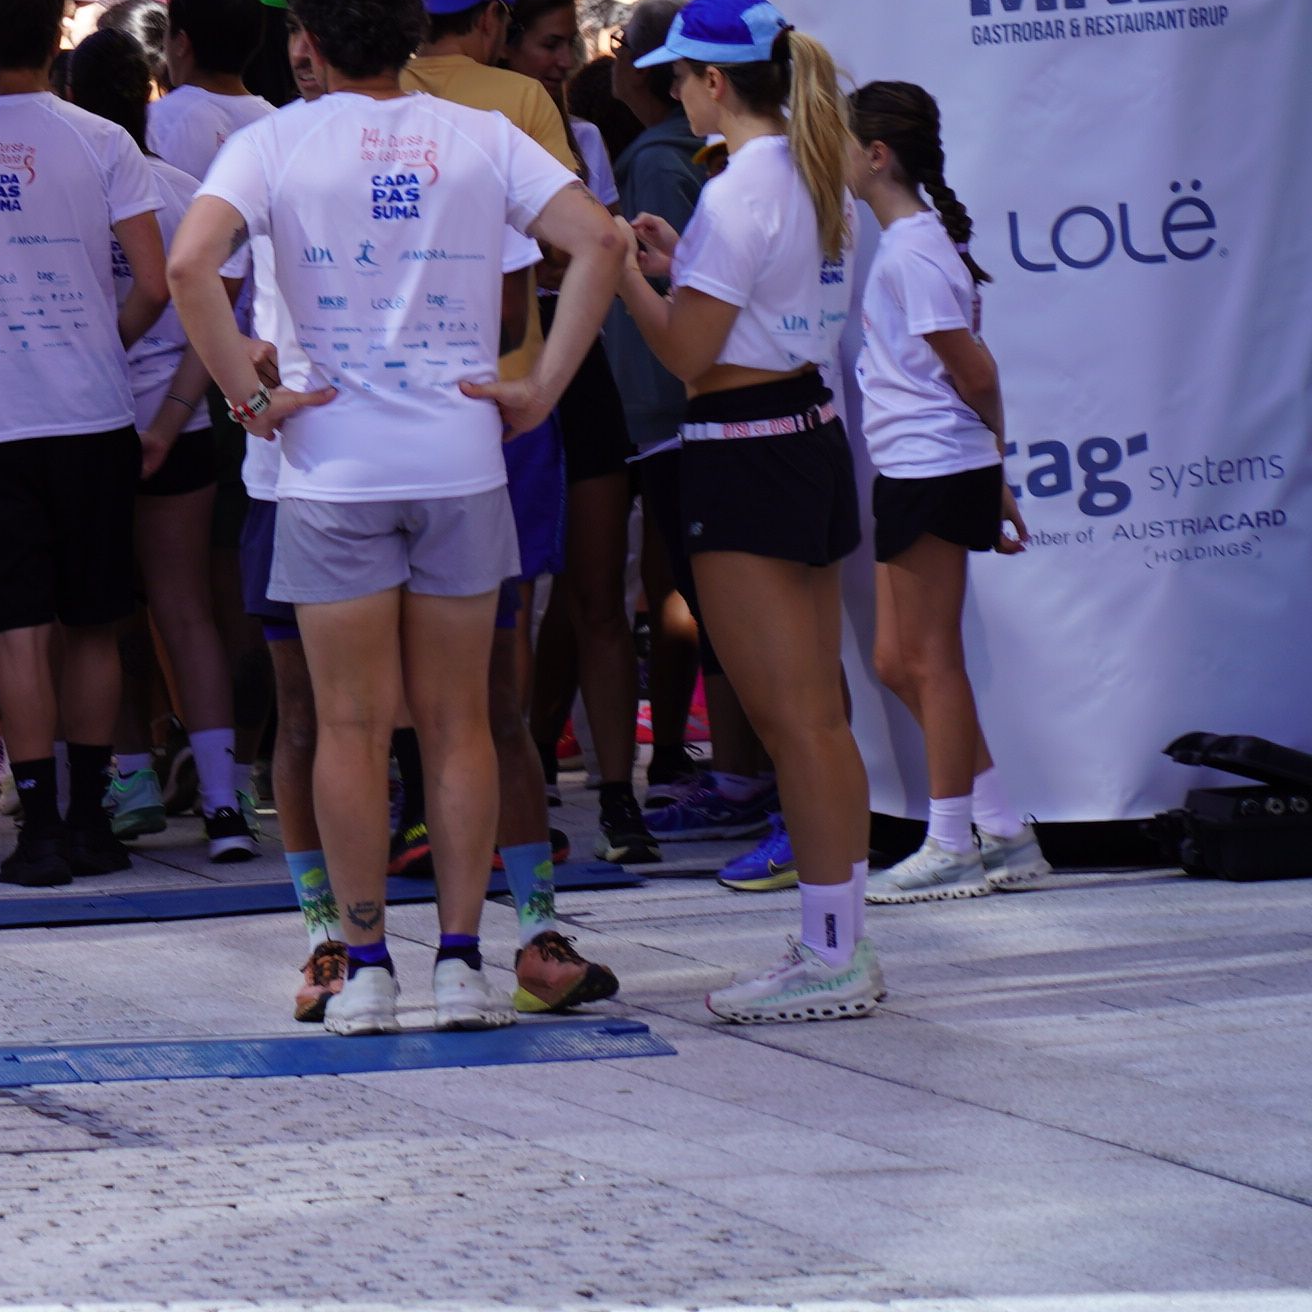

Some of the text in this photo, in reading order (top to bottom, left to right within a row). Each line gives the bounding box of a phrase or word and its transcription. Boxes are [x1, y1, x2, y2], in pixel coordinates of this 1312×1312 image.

[972, 4, 1229, 47] GASTROBAR & RESTAURANT GRUP
[371, 172, 420, 187] CADA
[372, 187, 421, 203] PAS
[372, 205, 420, 220] SUMA
[1148, 454, 1285, 499] systems
[1075, 526, 1095, 545] of
[1112, 509, 1287, 542] AUSTRIACARD
